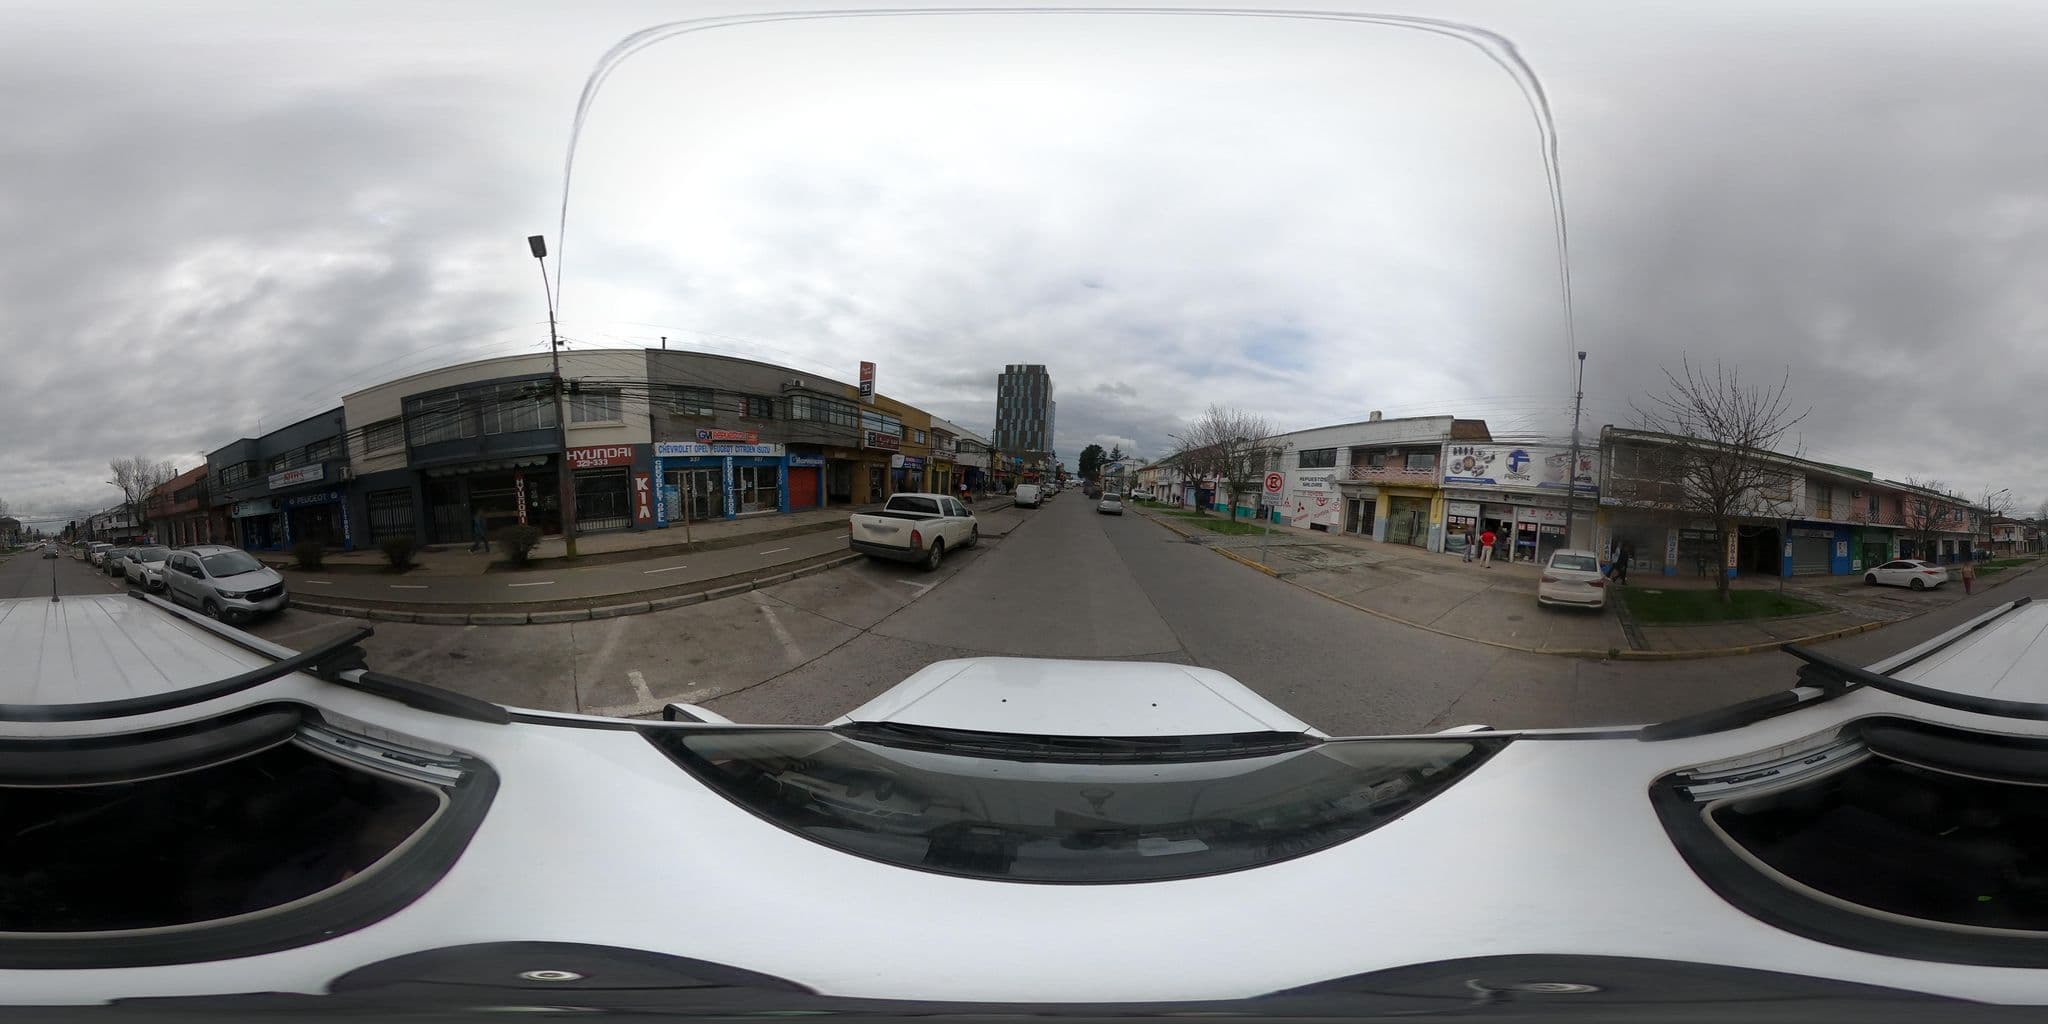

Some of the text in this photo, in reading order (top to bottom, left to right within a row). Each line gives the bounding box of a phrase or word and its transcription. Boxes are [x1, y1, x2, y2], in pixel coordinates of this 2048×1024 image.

[566, 447, 632, 460] HYUNDAI
[658, 445, 692, 454] CHEVROLET
[694, 445, 708, 453] OPEL
[710, 445, 733, 454] PEUGEOT
[296, 493, 327, 505] PEUGEOT
[516, 479, 527, 524] HYUNDAI
[635, 477, 651, 519] KIA
